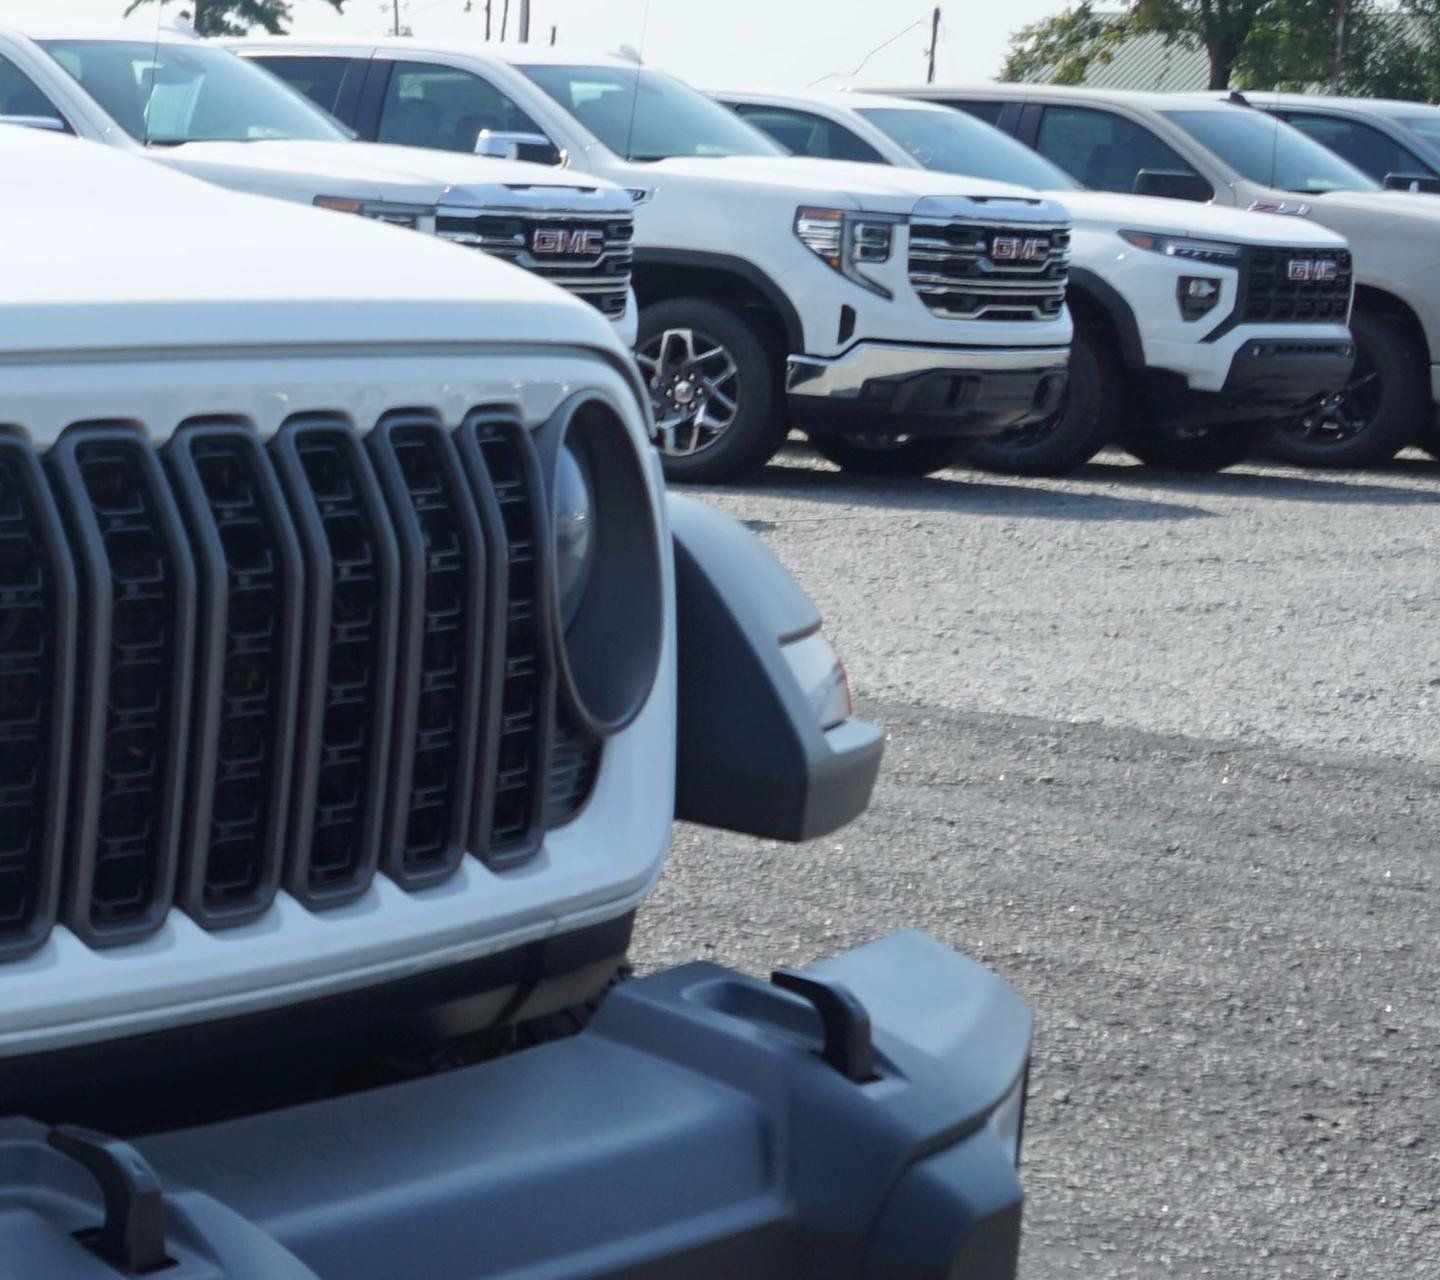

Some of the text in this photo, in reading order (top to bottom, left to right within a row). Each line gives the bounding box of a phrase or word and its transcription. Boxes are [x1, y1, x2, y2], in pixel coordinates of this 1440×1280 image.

[532, 228, 604, 254] GMC
[991, 236, 1050, 260] GMC
[1287, 259, 1336, 281] GMC
